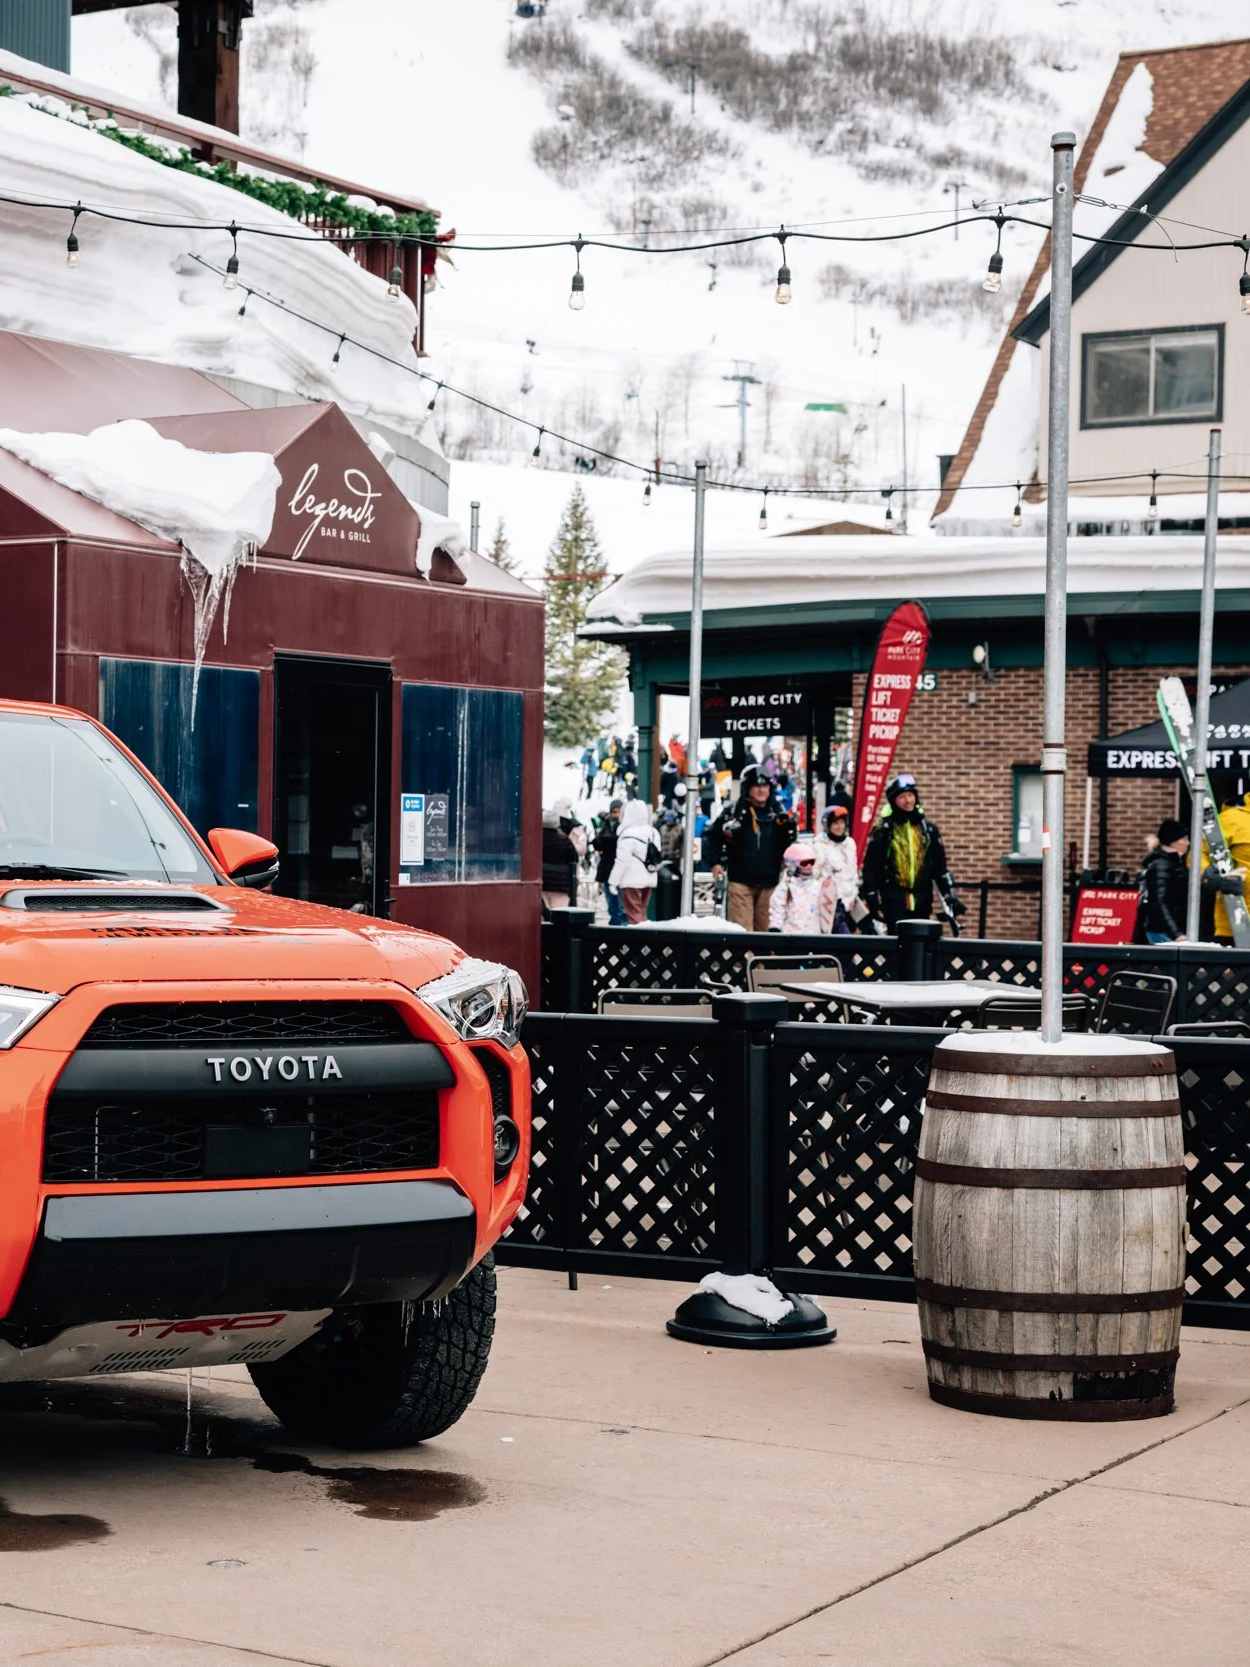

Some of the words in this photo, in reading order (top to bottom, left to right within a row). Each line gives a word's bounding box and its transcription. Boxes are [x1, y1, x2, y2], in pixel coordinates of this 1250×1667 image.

[288, 463, 383, 560] legends
[320, 526, 338, 538] BAR
[339, 529, 346, 539] &
[348, 531, 371, 543] GRILL
[873, 673, 912, 690] EXPRESS
[730, 695, 766, 708] PARK
[769, 693, 803, 706] CITY
[871, 691, 892, 706] LIFT
[870, 708, 901, 723] TICKET
[724, 717, 782, 732] TICKETS
[868, 724, 900, 740] PICKUP
[1106, 749, 1183, 769] EXPRES
[1205, 749, 1234, 769] IFT
[1096, 890, 1118, 900] PARK
[1118, 891, 1139, 900] CITY
[1082, 907, 1113, 918] EXPRESS
[1096, 917, 1122, 927] TICKET
[1079, 925, 1106, 935] PICKUP
[206, 1054, 344, 1083] TOYOTA
[116, 1313, 288, 1340] TRD
